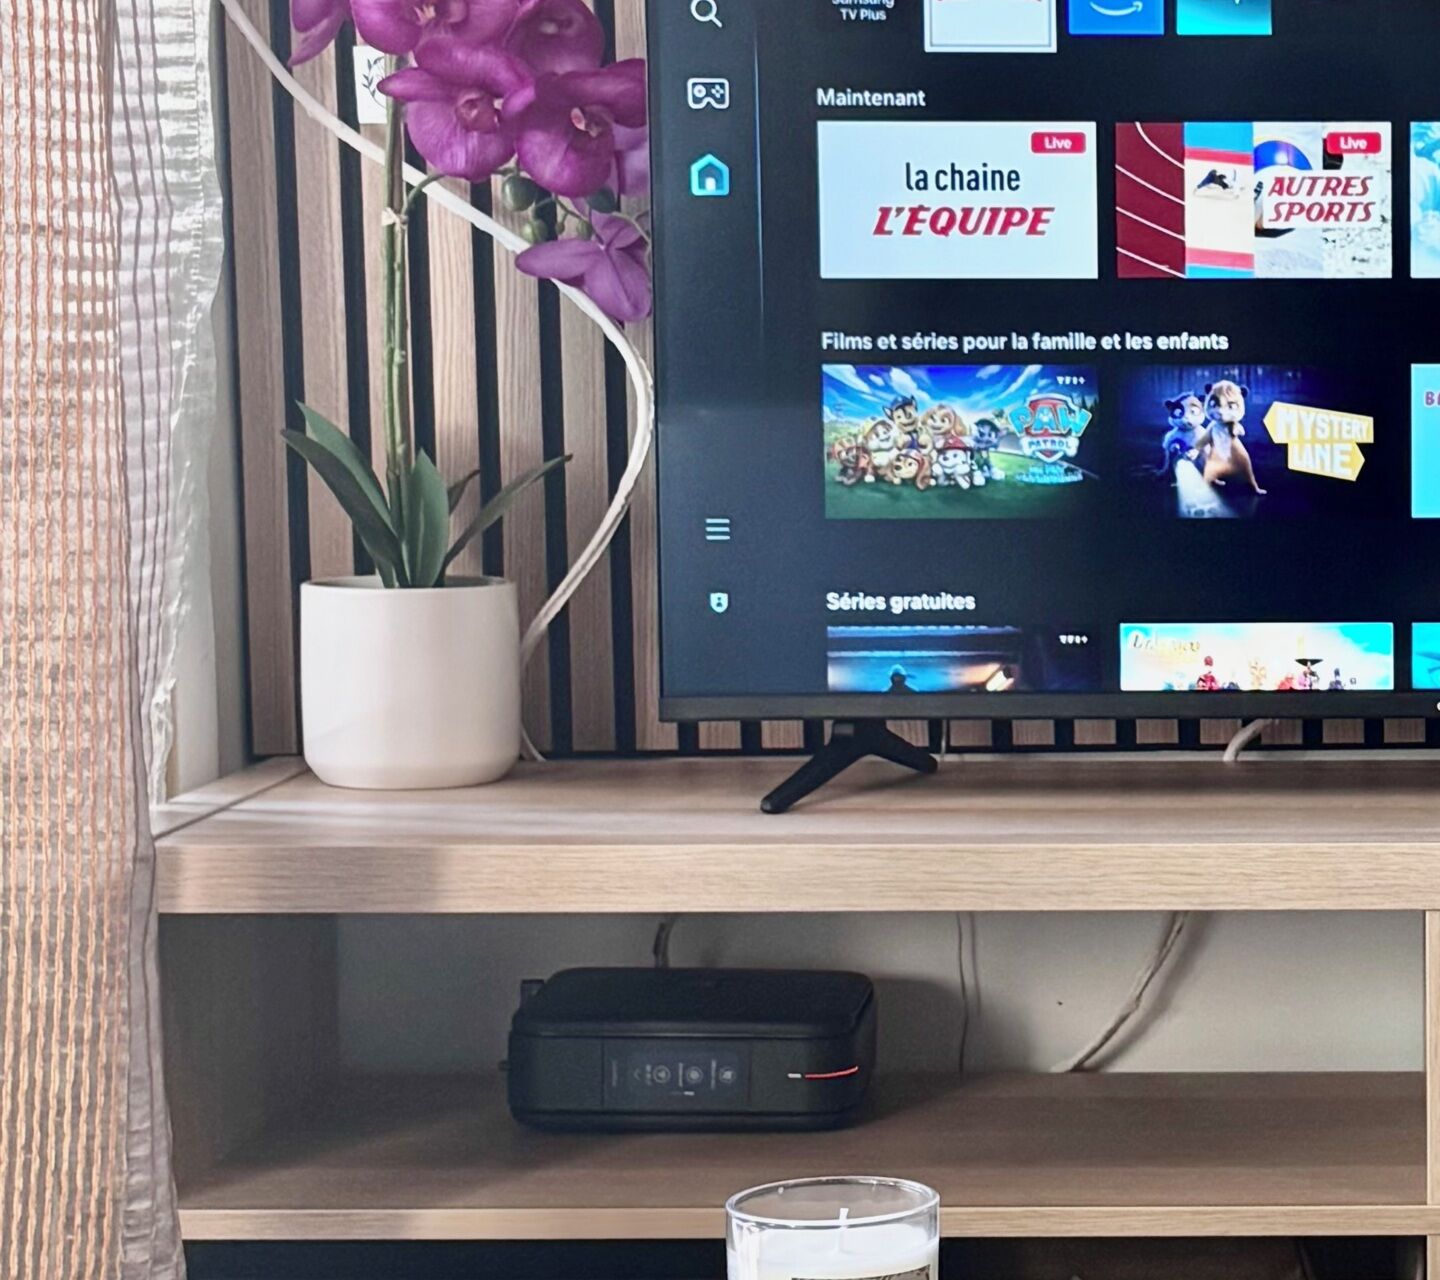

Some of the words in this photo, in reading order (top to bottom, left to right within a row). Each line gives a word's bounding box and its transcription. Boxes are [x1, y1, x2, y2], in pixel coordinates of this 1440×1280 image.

[840, 9, 857, 20] TV
[860, 9, 887, 20] Plus
[816, 88, 926, 107] Maintenant
[1044, 136, 1072, 150] Live
[1339, 136, 1367, 149] Live
[906, 162, 928, 191] la
[935, 162, 1021, 192] chaine
[1268, 176, 1373, 196] AUTRES
[872, 205, 1055, 237] L'ÉQUIPE
[1268, 202, 1376, 222] SPORTS
[821, 332, 873, 350] Films
[877, 333, 897, 350] et
[901, 332, 959, 351] séries
[963, 336, 1007, 354] pour
[1011, 332, 1028, 350] la
[1032, 332, 1097, 350] famille
[1101, 333, 1121, 350] et
[1125, 332, 1153, 350] les
[1156, 332, 1229, 350] enfants
[1008, 405, 1092, 437] PAW
[1276, 408, 1371, 442] MYSTERY
[1028, 439, 1071, 449] PATROL
[1292, 443, 1352, 477] LANE
[826, 592, 886, 611] Séries
[890, 593, 976, 614] gratuites
